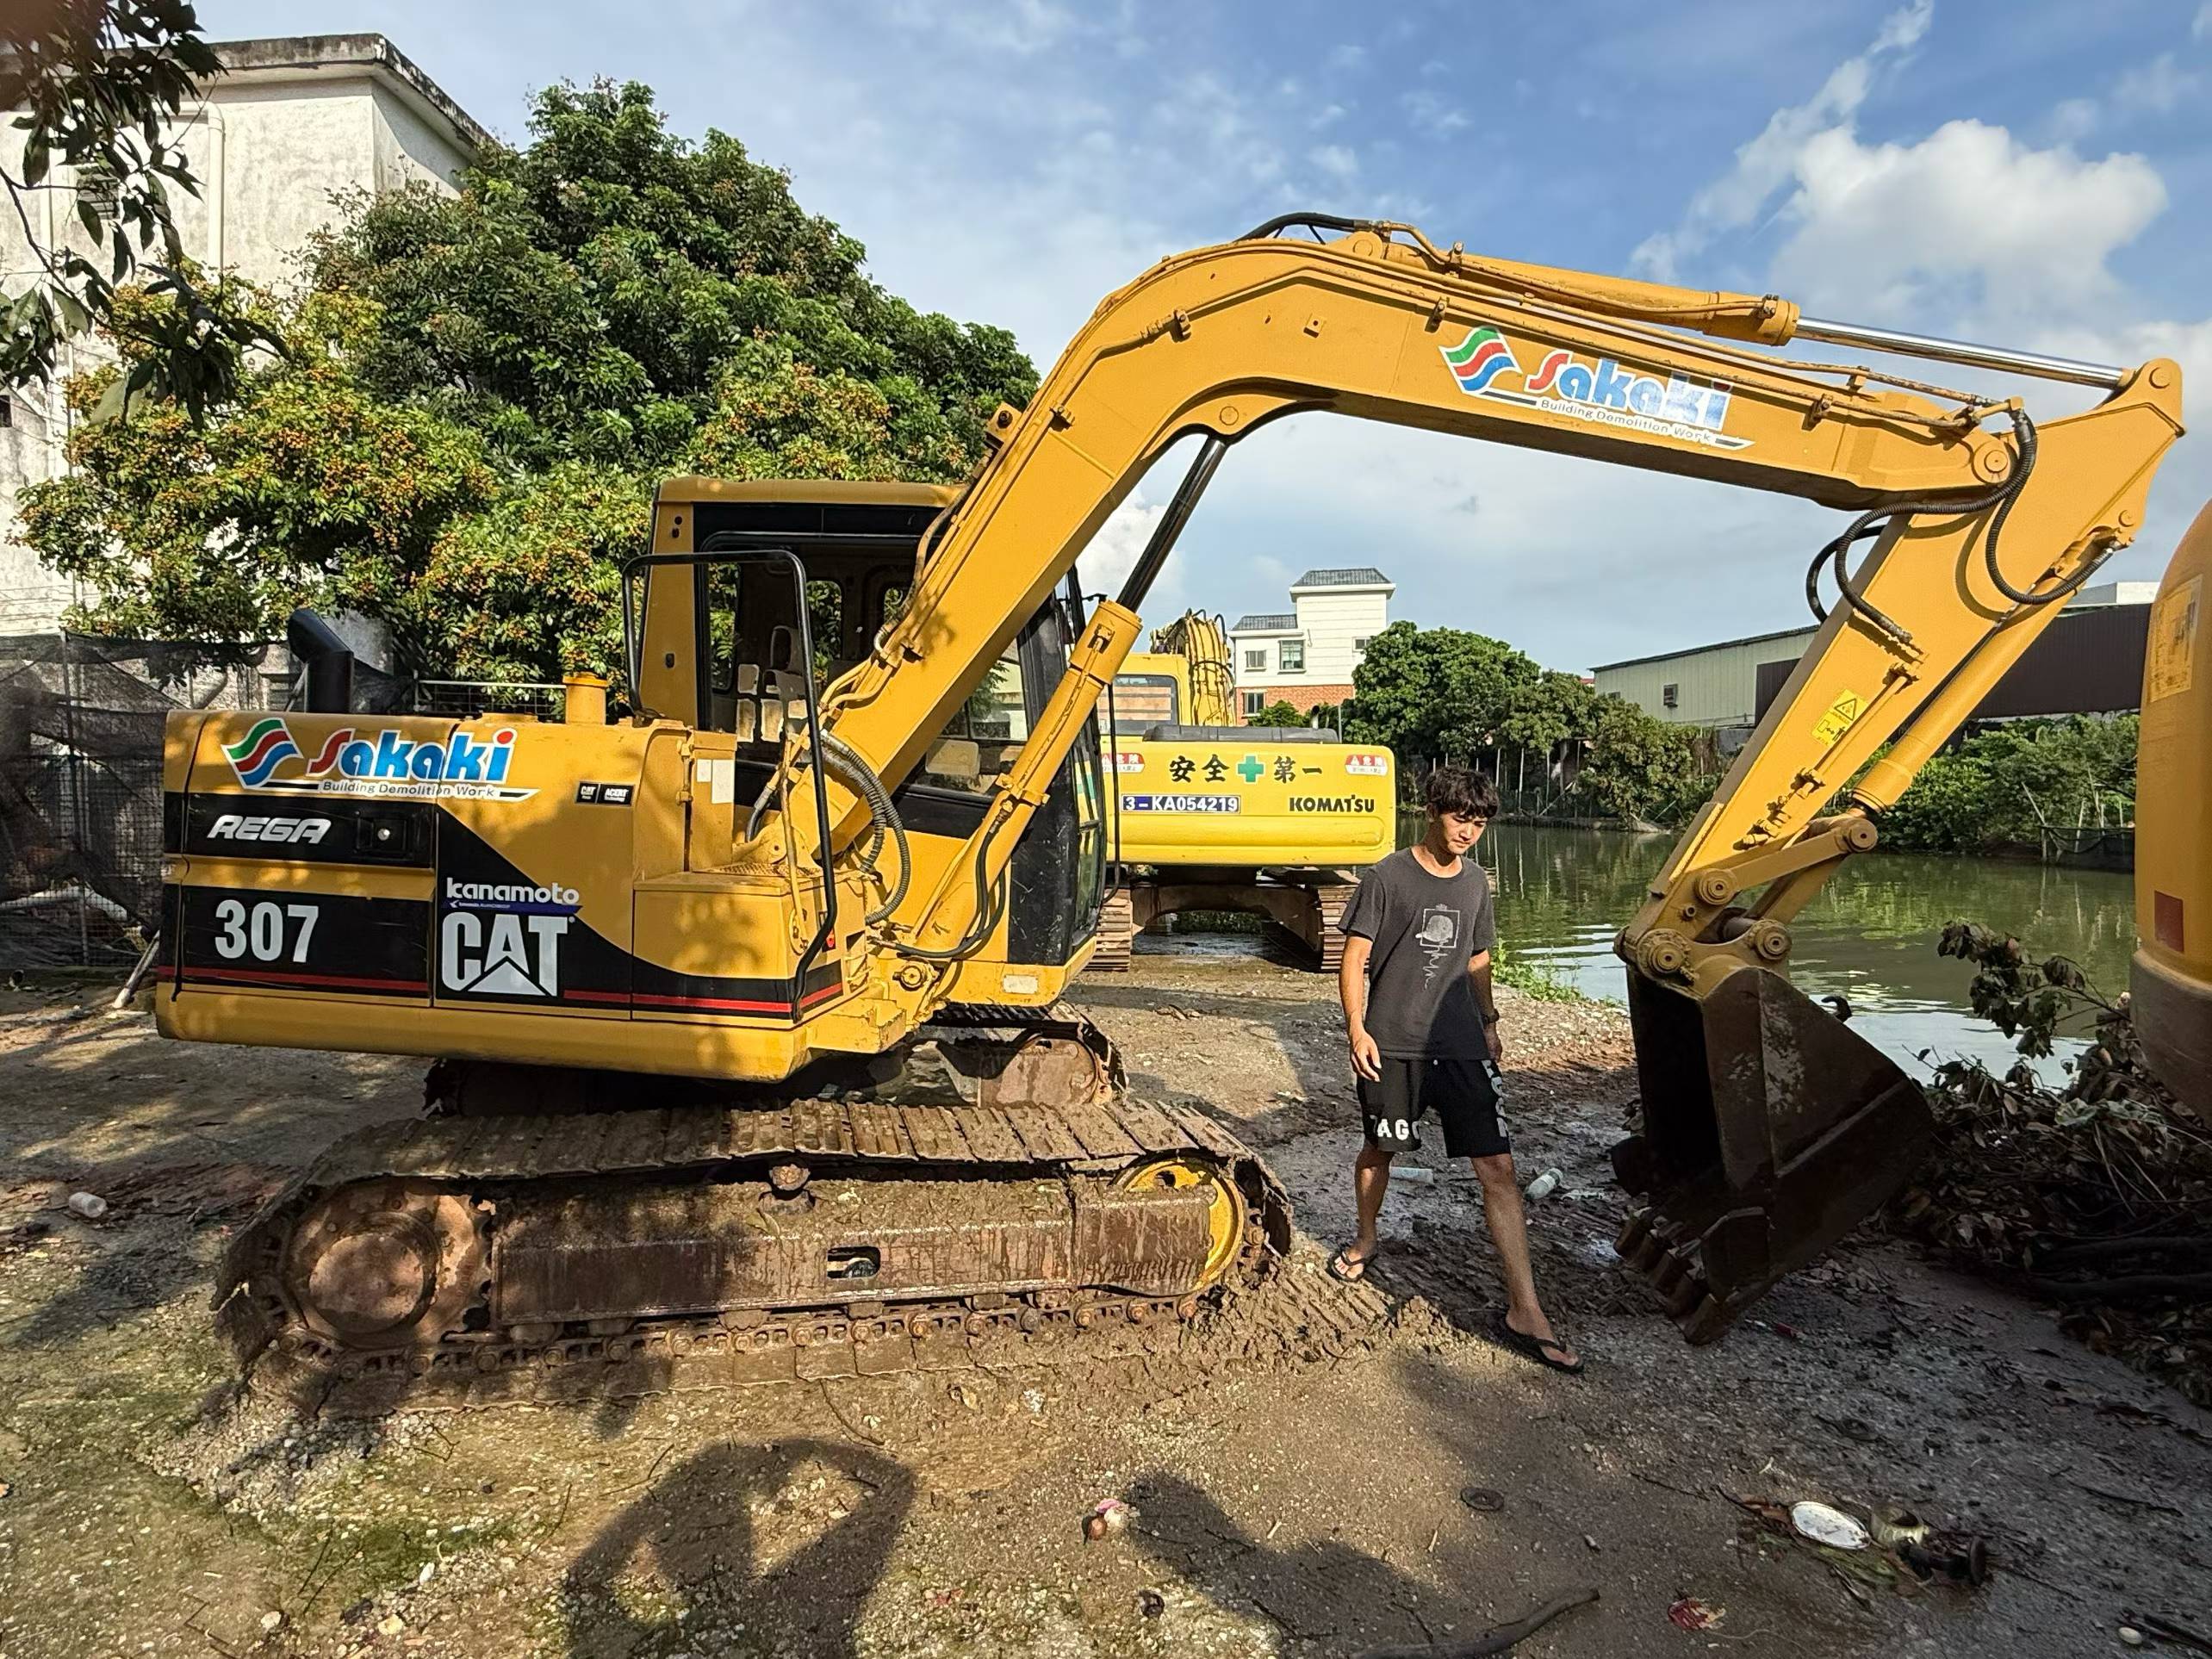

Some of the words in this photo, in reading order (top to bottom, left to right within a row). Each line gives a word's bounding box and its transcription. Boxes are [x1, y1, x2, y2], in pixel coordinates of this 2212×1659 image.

[1525, 350, 1733, 432] Sakaki
[1541, 399, 1594, 418] Building
[1596, 409, 1668, 432] Demolition
[1674, 426, 1712, 442] Work
[306, 728, 515, 784] Sakaki
[1169, 754, 1229, 783] 安全
[1274, 756, 1322, 784] 第一
[322, 781, 376, 794] Building
[378, 782, 451, 796] Demolition
[456, 786, 494, 798] Work
[1289, 794, 1375, 813] KOMATSU
[446, 877, 580, 904] kanamoto
[214, 899, 320, 963] 307
[442, 911, 569, 997] CAT
